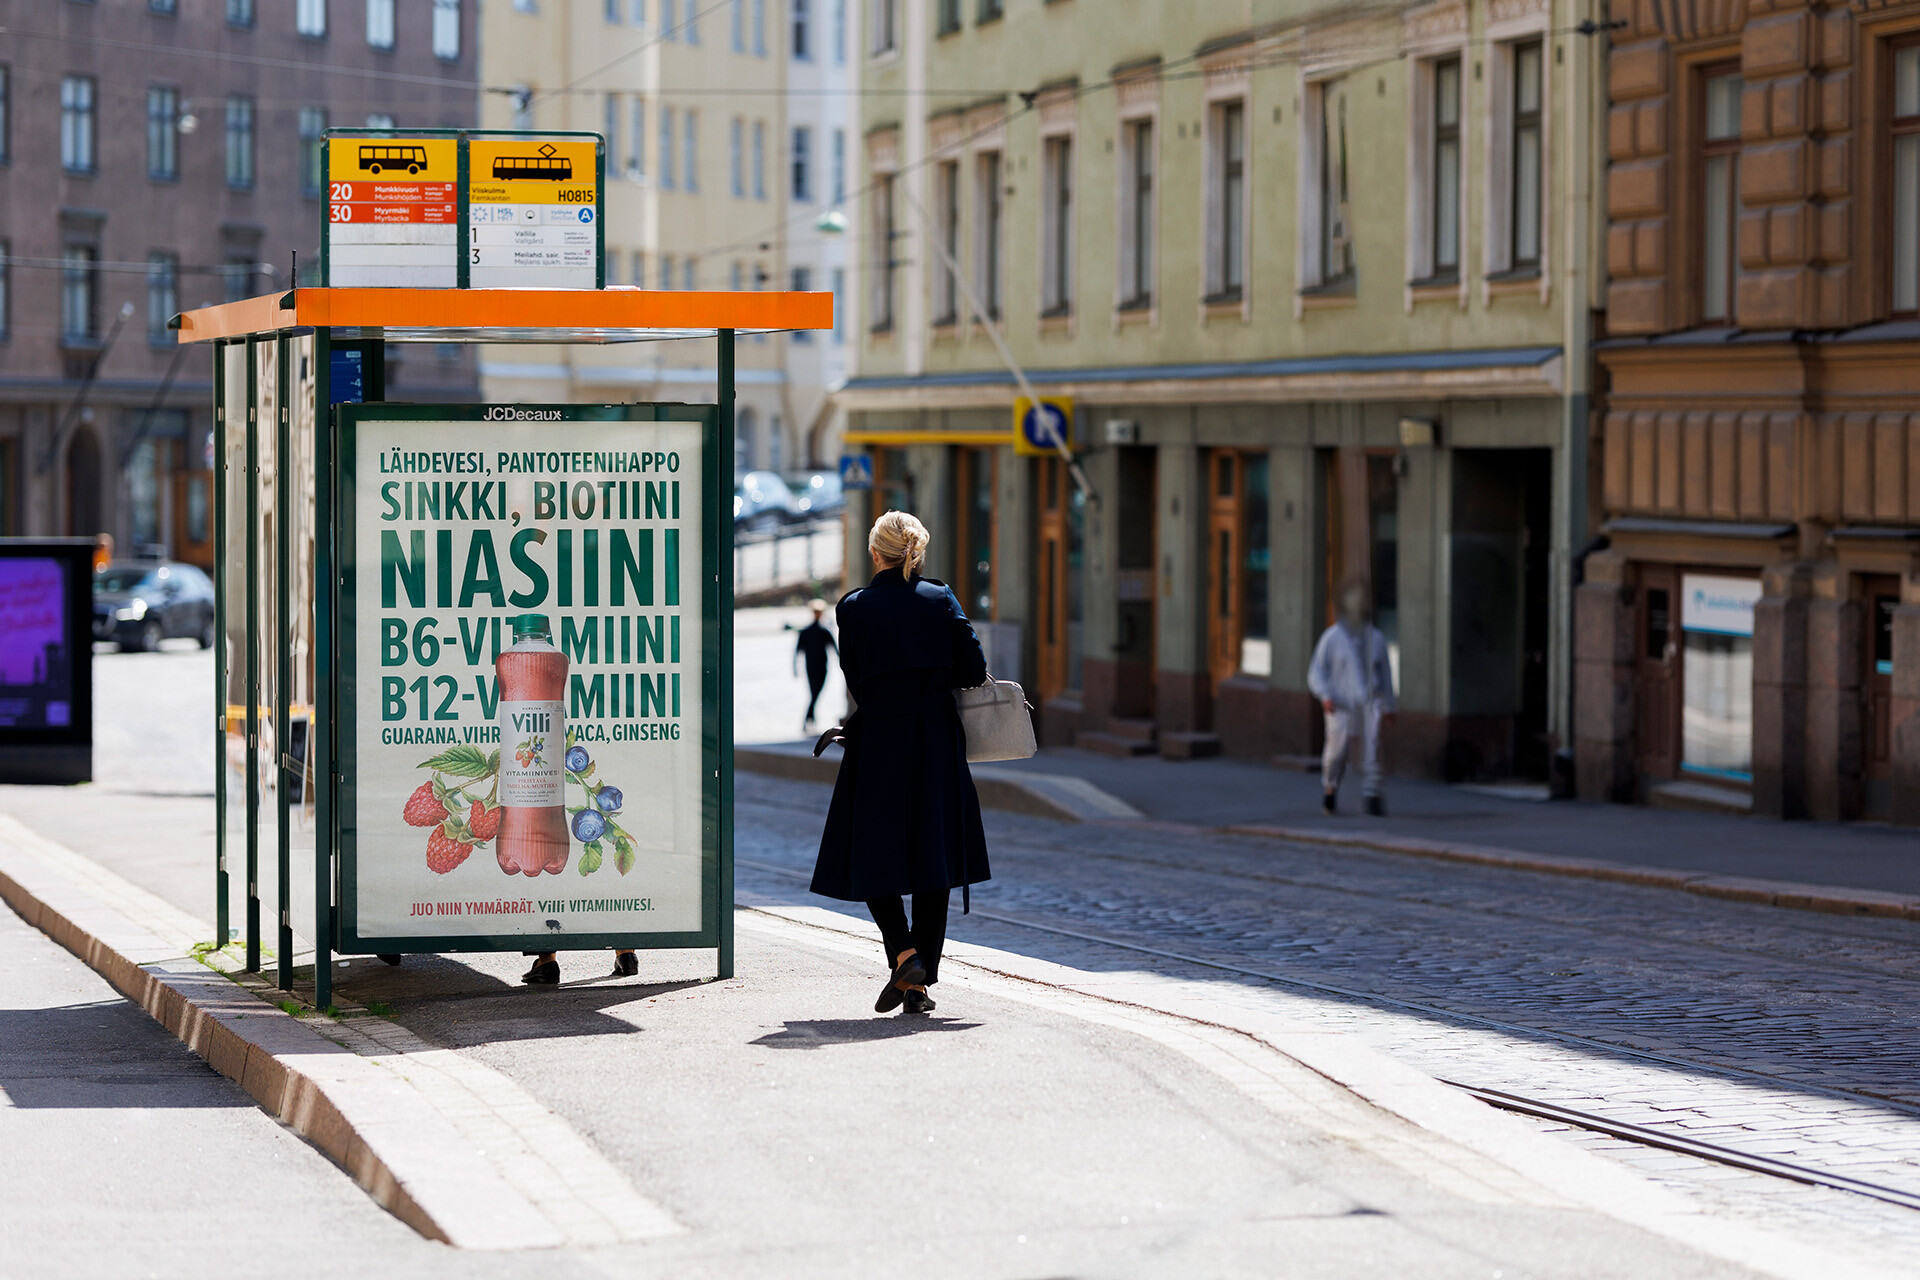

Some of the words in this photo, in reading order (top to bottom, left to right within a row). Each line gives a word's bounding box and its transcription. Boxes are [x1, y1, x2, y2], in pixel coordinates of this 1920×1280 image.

[331, 183, 352, 200] 20
[558, 190, 594, 202] H0815
[331, 204, 352, 222] 30
[374, 207, 410, 215] Myyrmäki
[374, 215, 410, 223] Myrbacka
[471, 227, 477, 243] 1
[471, 248, 480, 264] 3
[483, 406, 562, 421] JCDecaux
[380, 446, 492, 477] LÄHDEVESI,
[497, 451, 680, 474] PANTOTEENIHAPPO
[380, 480, 521, 528] SINKKI,
[534, 480, 680, 520] BIOTIINI
[380, 527, 680, 609] NIASIINI
[511, 712, 550, 733] Villi
[409, 902, 434, 916] JUO
[436, 902, 462, 916] NIIN
[465, 897, 535, 915] YMMÄRRÄT.
[538, 900, 565, 913] Villi
[569, 898, 656, 913] VITAMIINIVESI.
